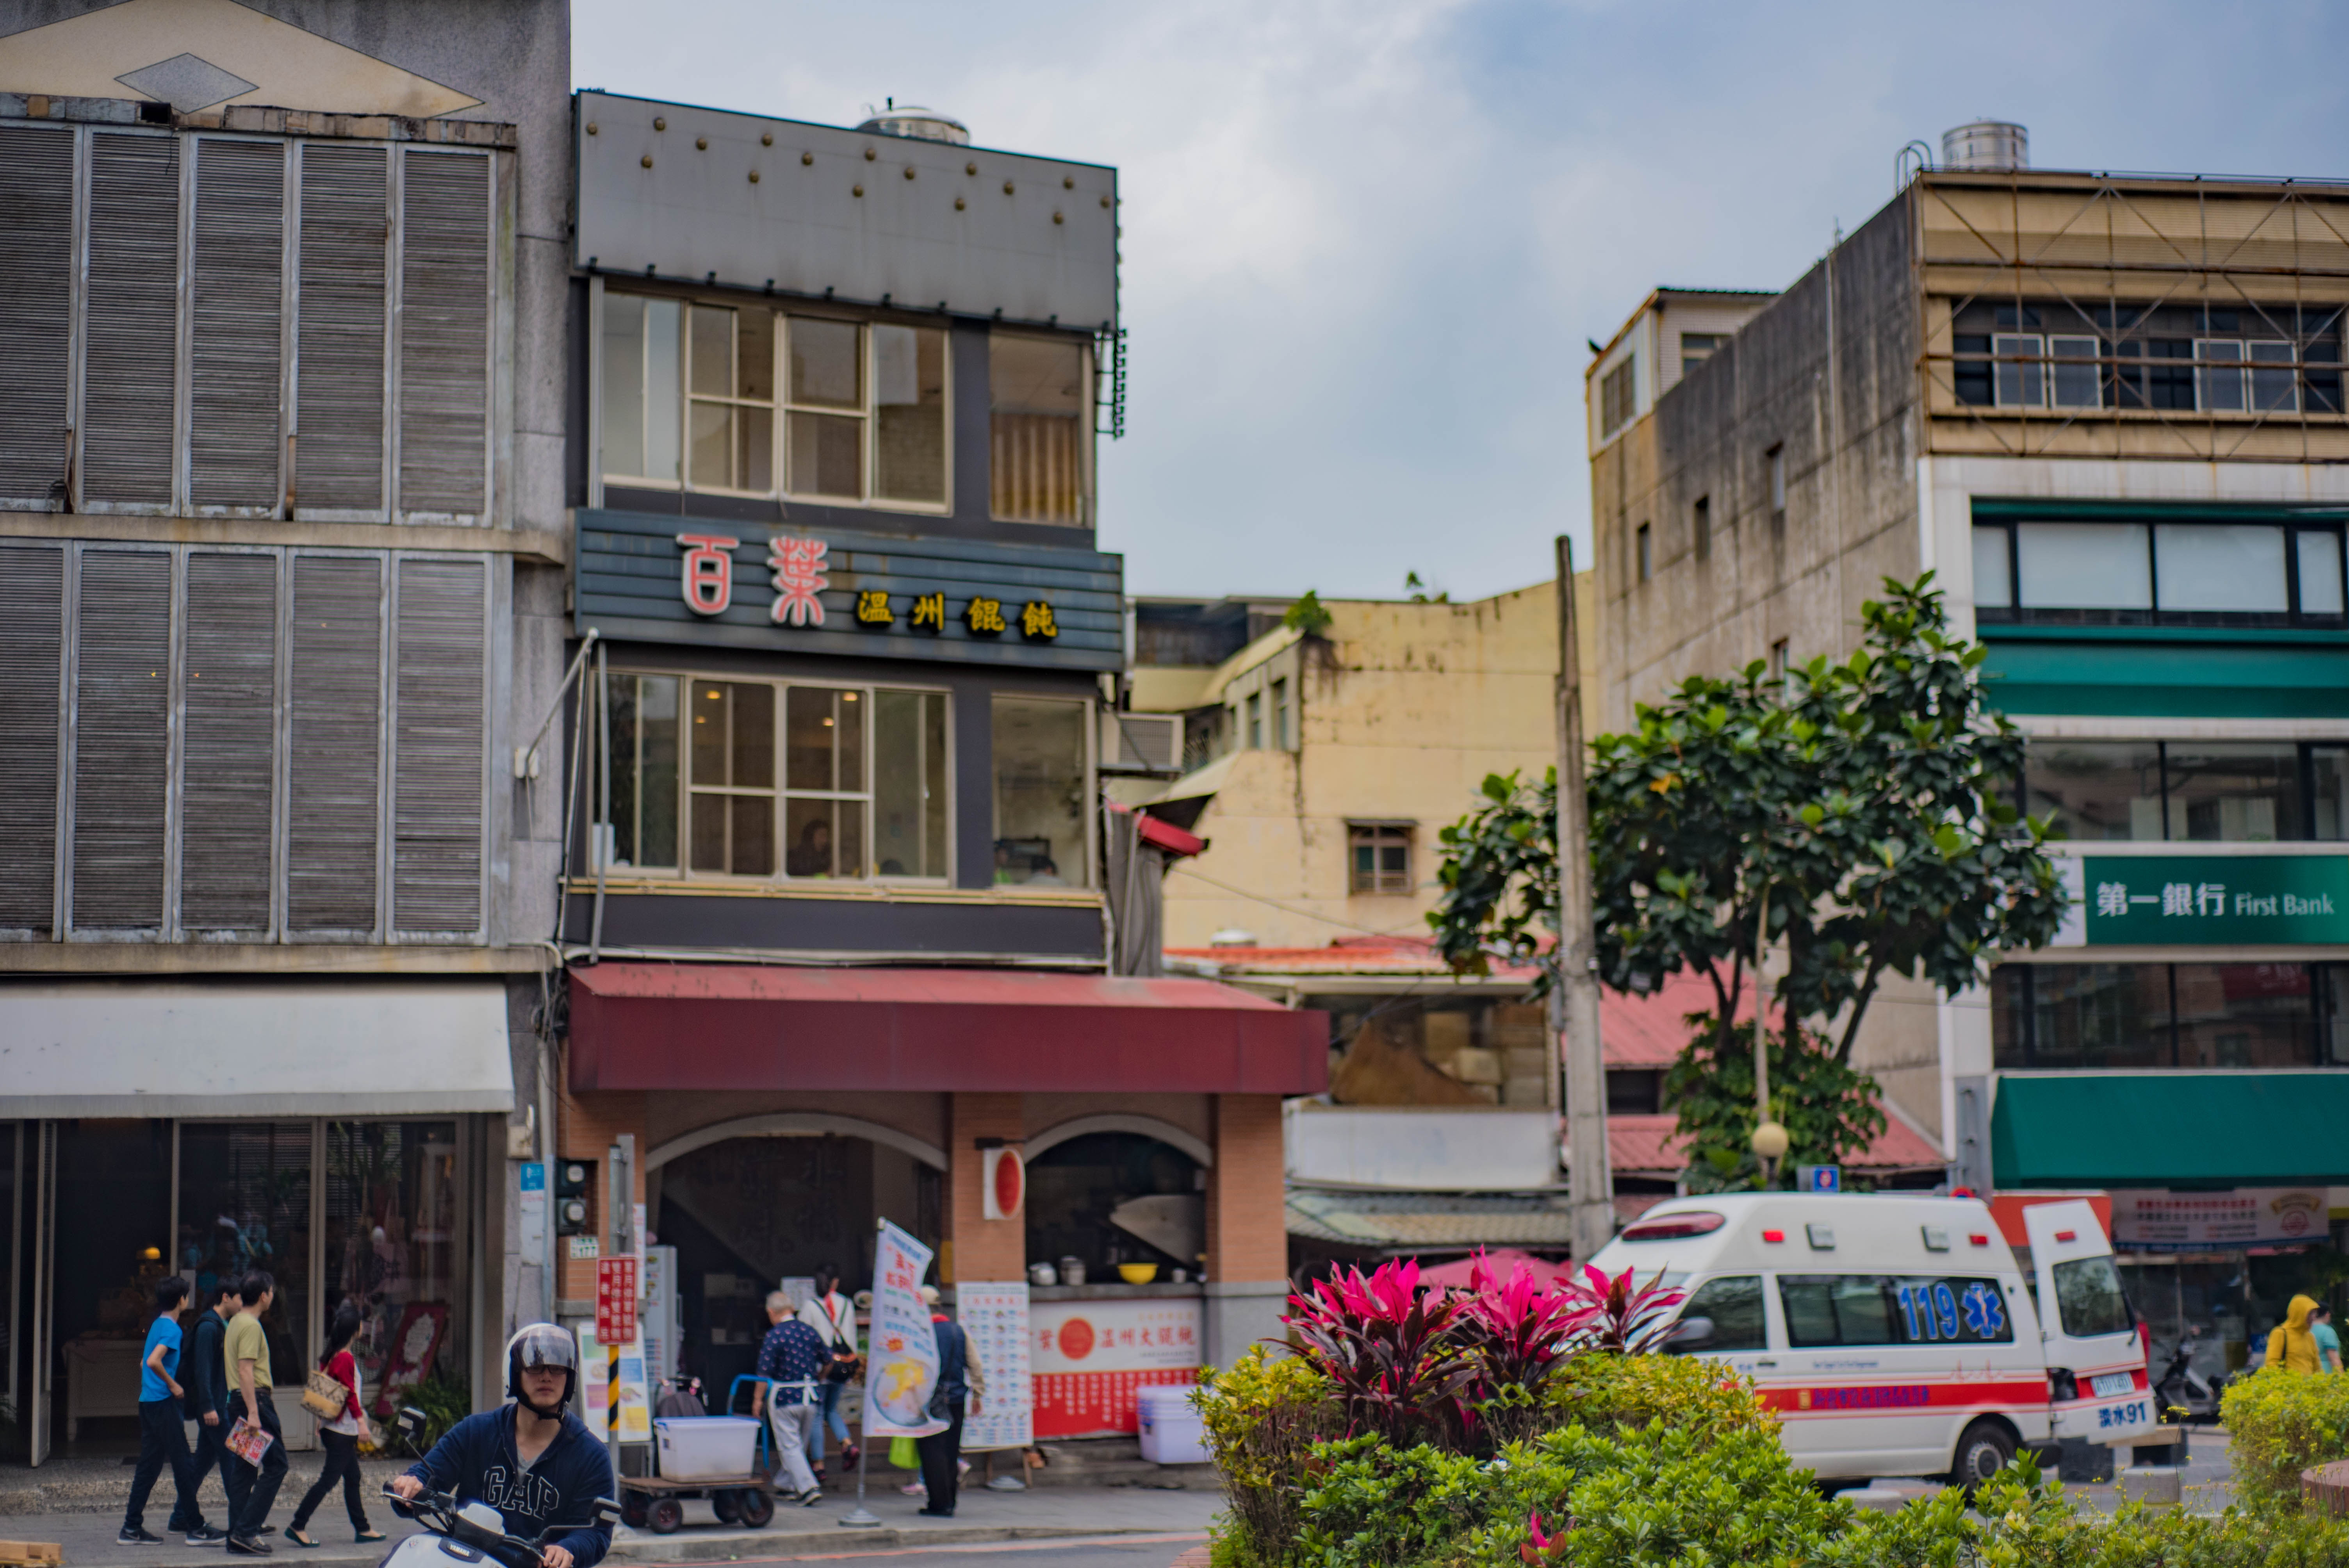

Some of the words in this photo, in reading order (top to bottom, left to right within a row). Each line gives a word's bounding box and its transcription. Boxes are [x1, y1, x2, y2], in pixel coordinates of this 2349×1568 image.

[2097, 882, 2226, 917] 第一銀行
[2235, 892, 2279, 916] First
[2284, 892, 2335, 916] Bank
[1896, 1282, 1959, 1340] 119
[483, 1466, 560, 1521] GAP
[450, 1543, 470, 1557] YAMAHA
